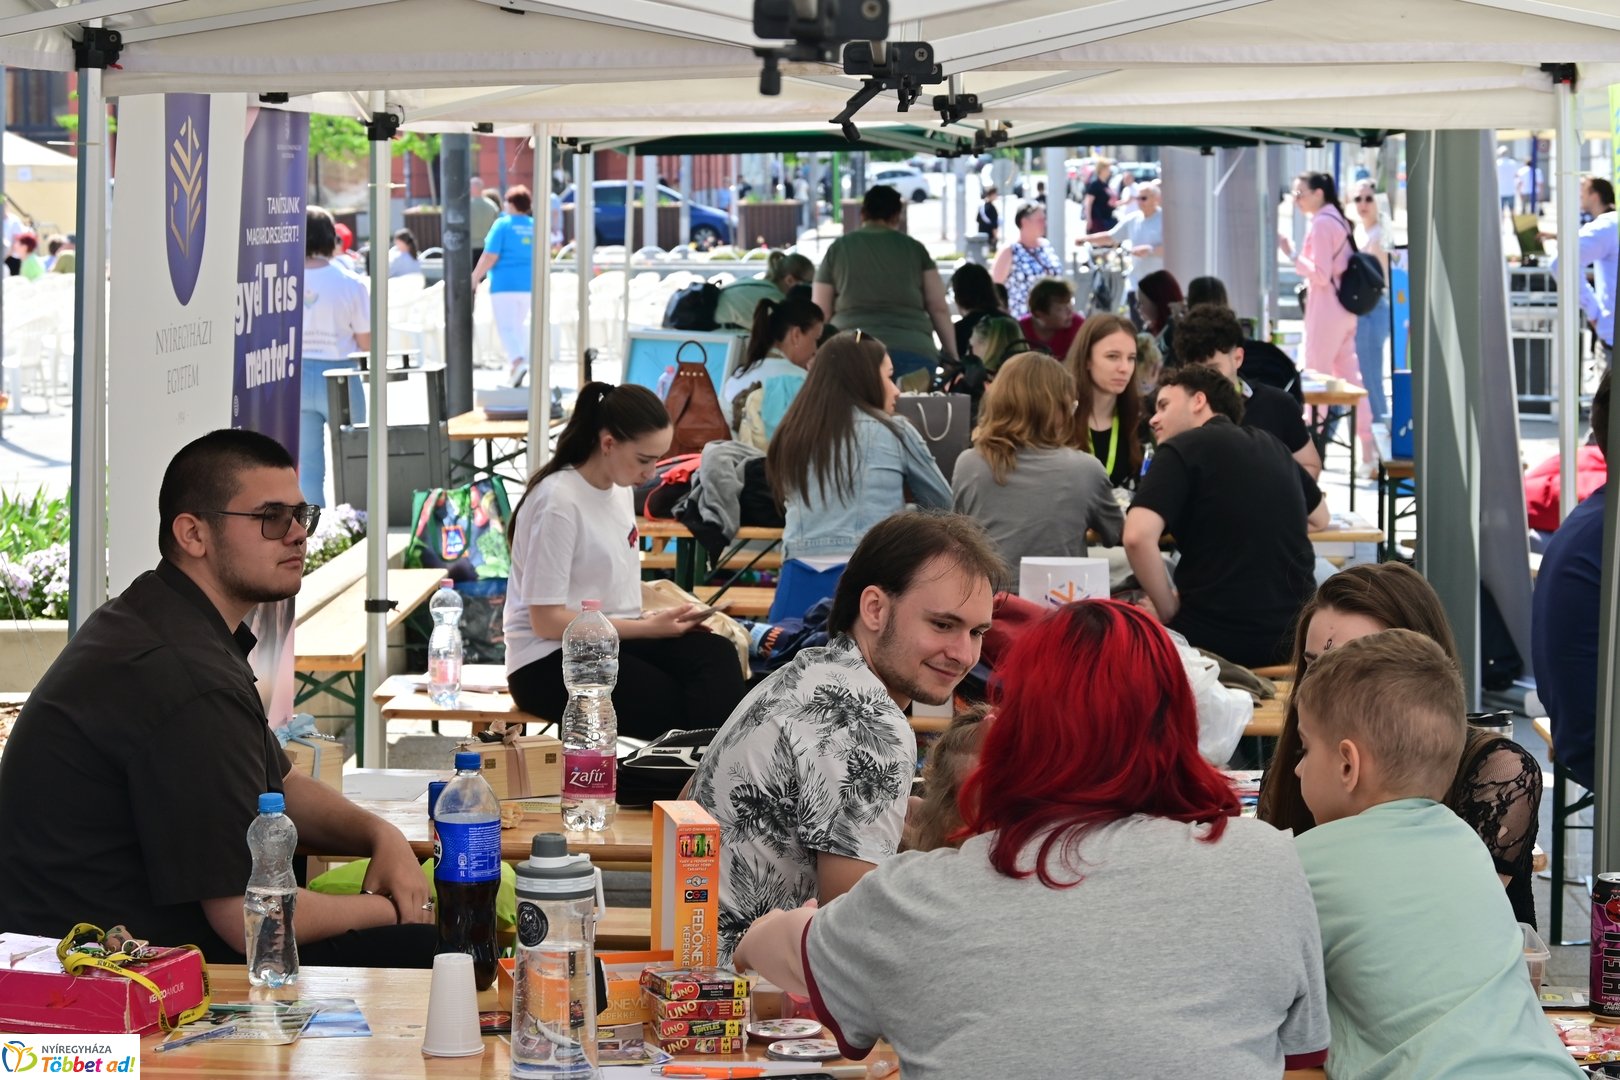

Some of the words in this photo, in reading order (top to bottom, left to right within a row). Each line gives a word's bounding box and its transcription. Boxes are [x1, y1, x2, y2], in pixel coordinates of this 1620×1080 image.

[155, 317, 212, 355] NYÍREGYHÁZI
[245, 326, 296, 389] mentor!
[167, 361, 199, 394] EGYETEM
[569, 768, 606, 789] zafír
[668, 1001, 697, 1019] UNO
[663, 1022, 685, 1036] UNO
